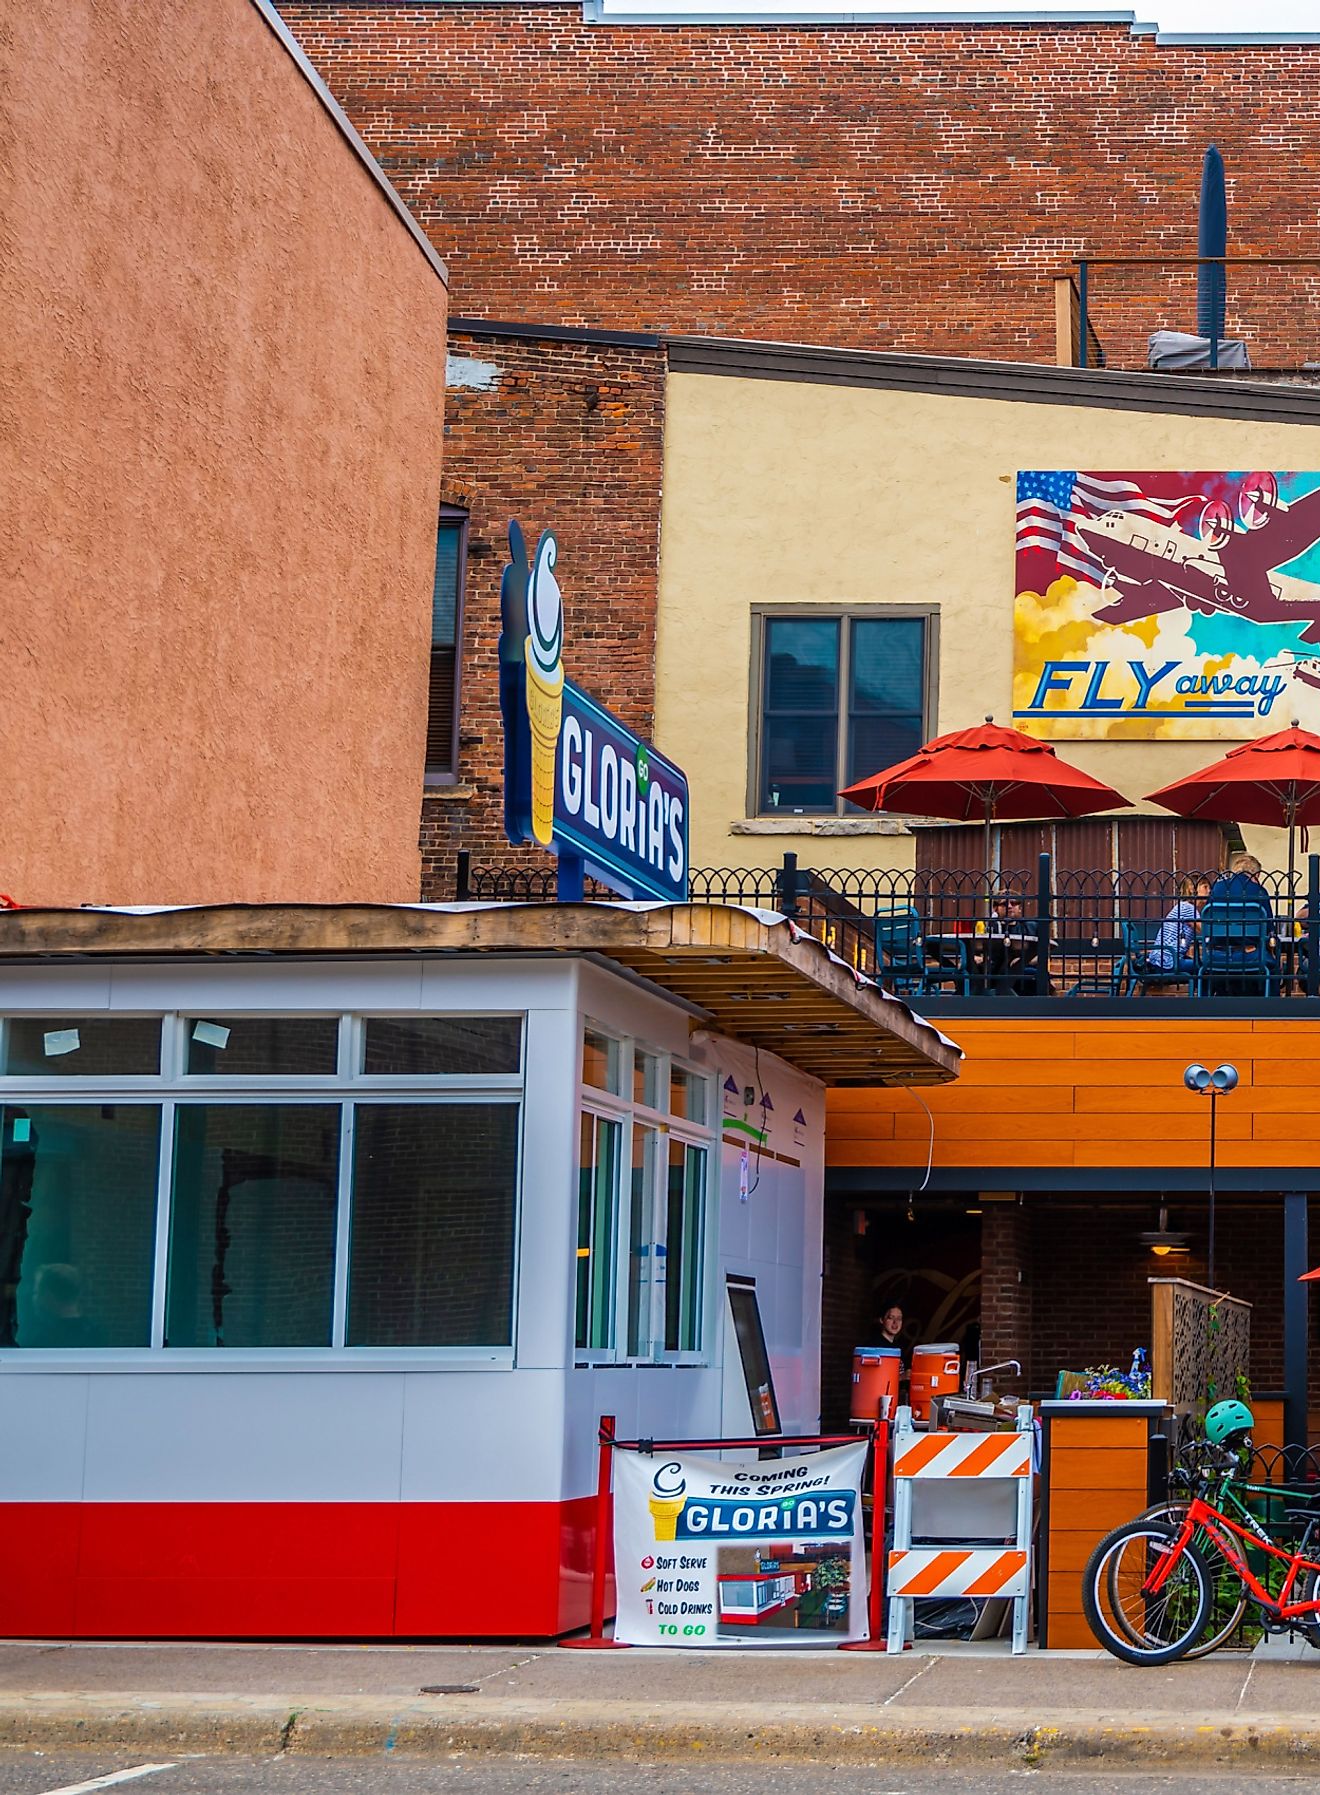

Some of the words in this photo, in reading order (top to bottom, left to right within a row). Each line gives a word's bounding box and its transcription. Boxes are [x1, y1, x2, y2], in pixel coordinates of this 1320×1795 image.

[1028, 660, 1182, 710] FLY
[1175, 671, 1288, 716] away
[638, 759, 649, 782] GO
[734, 1466, 808, 1482] COMING
[709, 1484, 750, 1496] THIS
[755, 1475, 831, 1496] SPRING!
[1245, 1511, 1273, 1545] TREK
[656, 1555, 678, 1570] SOFT
[679, 1555, 708, 1570] SERVE
[656, 1579, 674, 1592] HOT
[676, 1578, 700, 1592] DOGS
[658, 1601, 678, 1615] COLD
[680, 1601, 713, 1615] DRINKS
[658, 1624, 678, 1635] TO
[683, 1624, 706, 1636] GO
